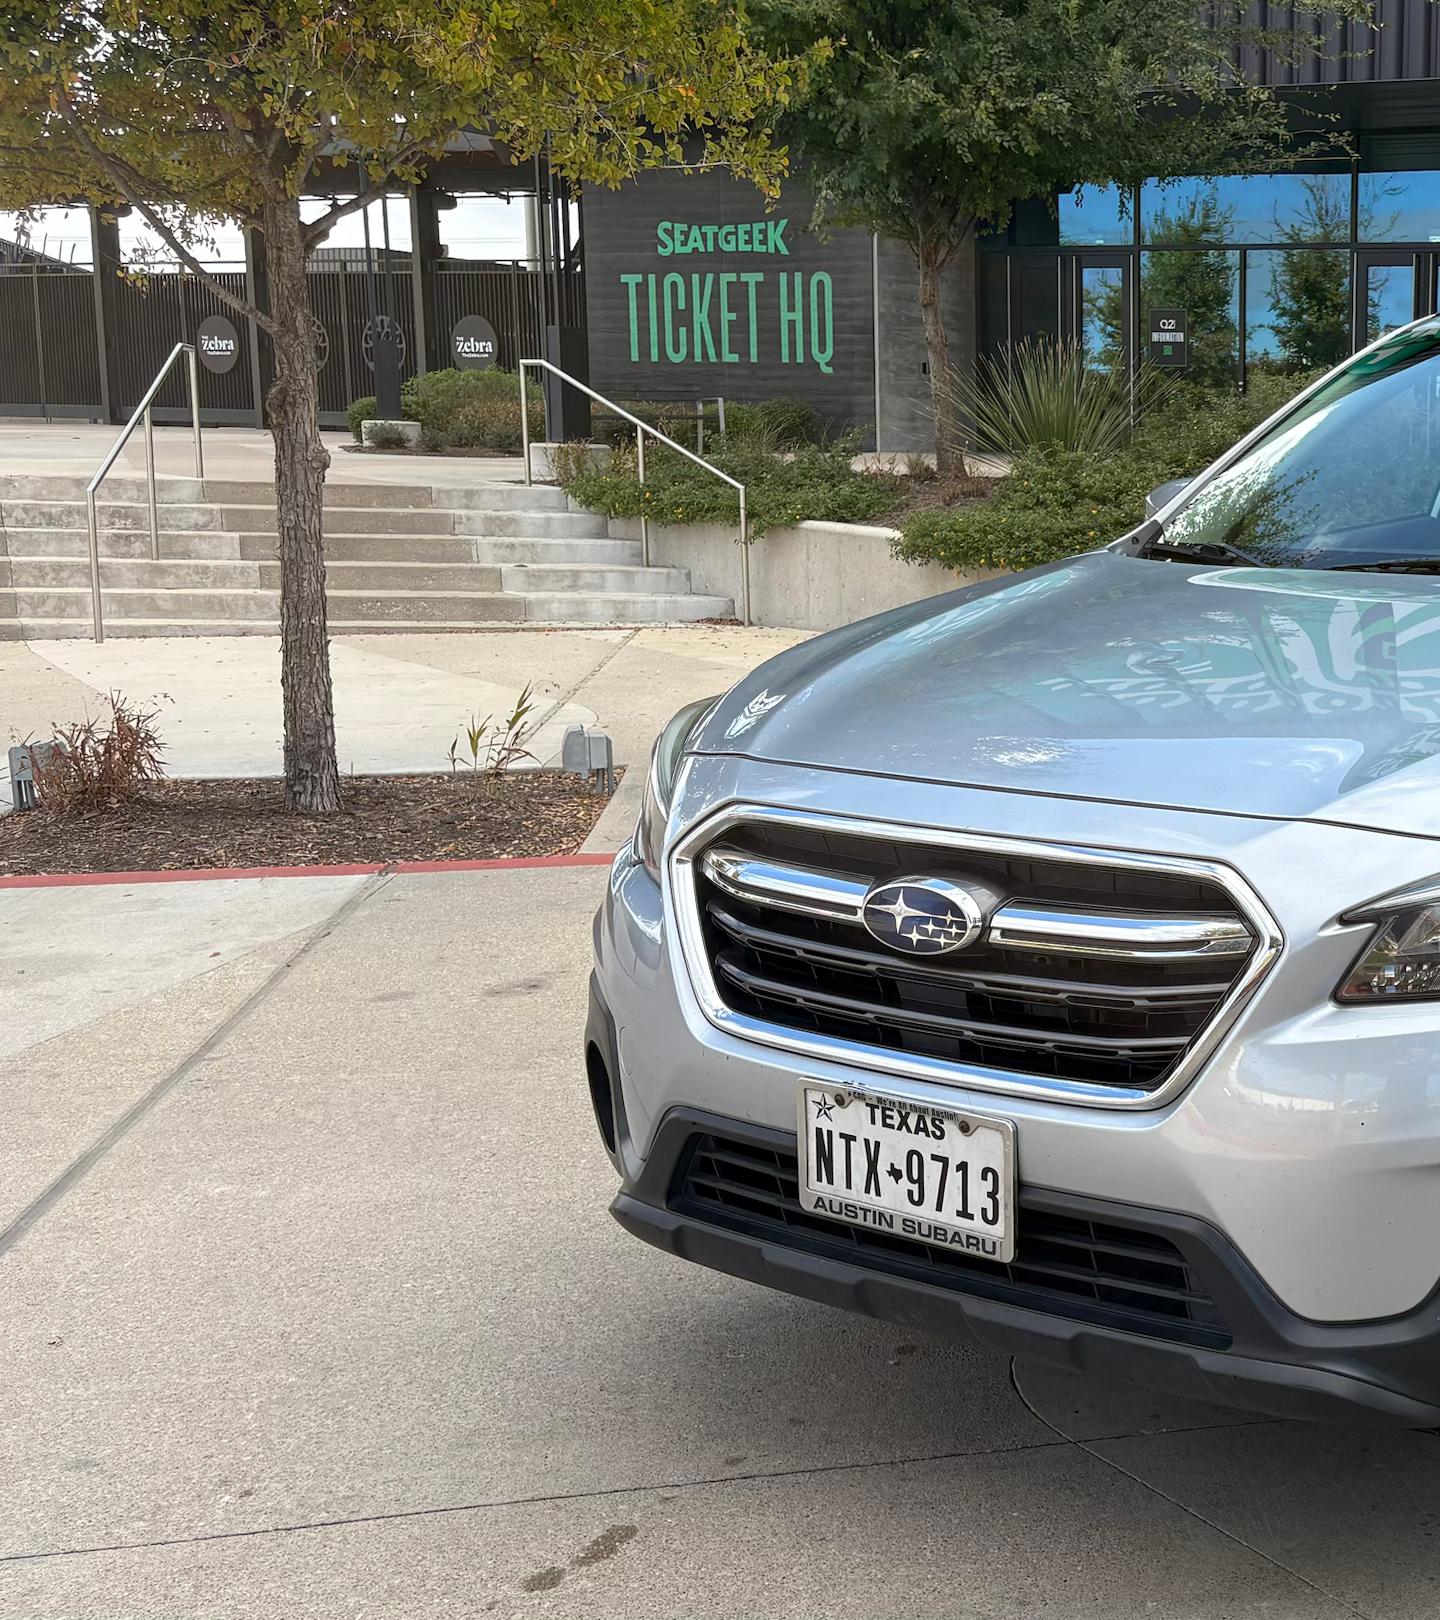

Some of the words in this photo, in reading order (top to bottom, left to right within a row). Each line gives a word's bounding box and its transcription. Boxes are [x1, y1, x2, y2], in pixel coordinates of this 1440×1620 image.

[657, 218, 790, 257] SEATGEEK
[620, 272, 764, 363] TICKET
[779, 271, 833, 374] HQ
[865, 1102, 946, 1140] TEXAS
[815, 1126, 881, 1198] NTX
[906, 1149, 999, 1226] 9713
[813, 1196, 894, 1229] AUSTIN
[902, 1218, 996, 1256] SUBARU
